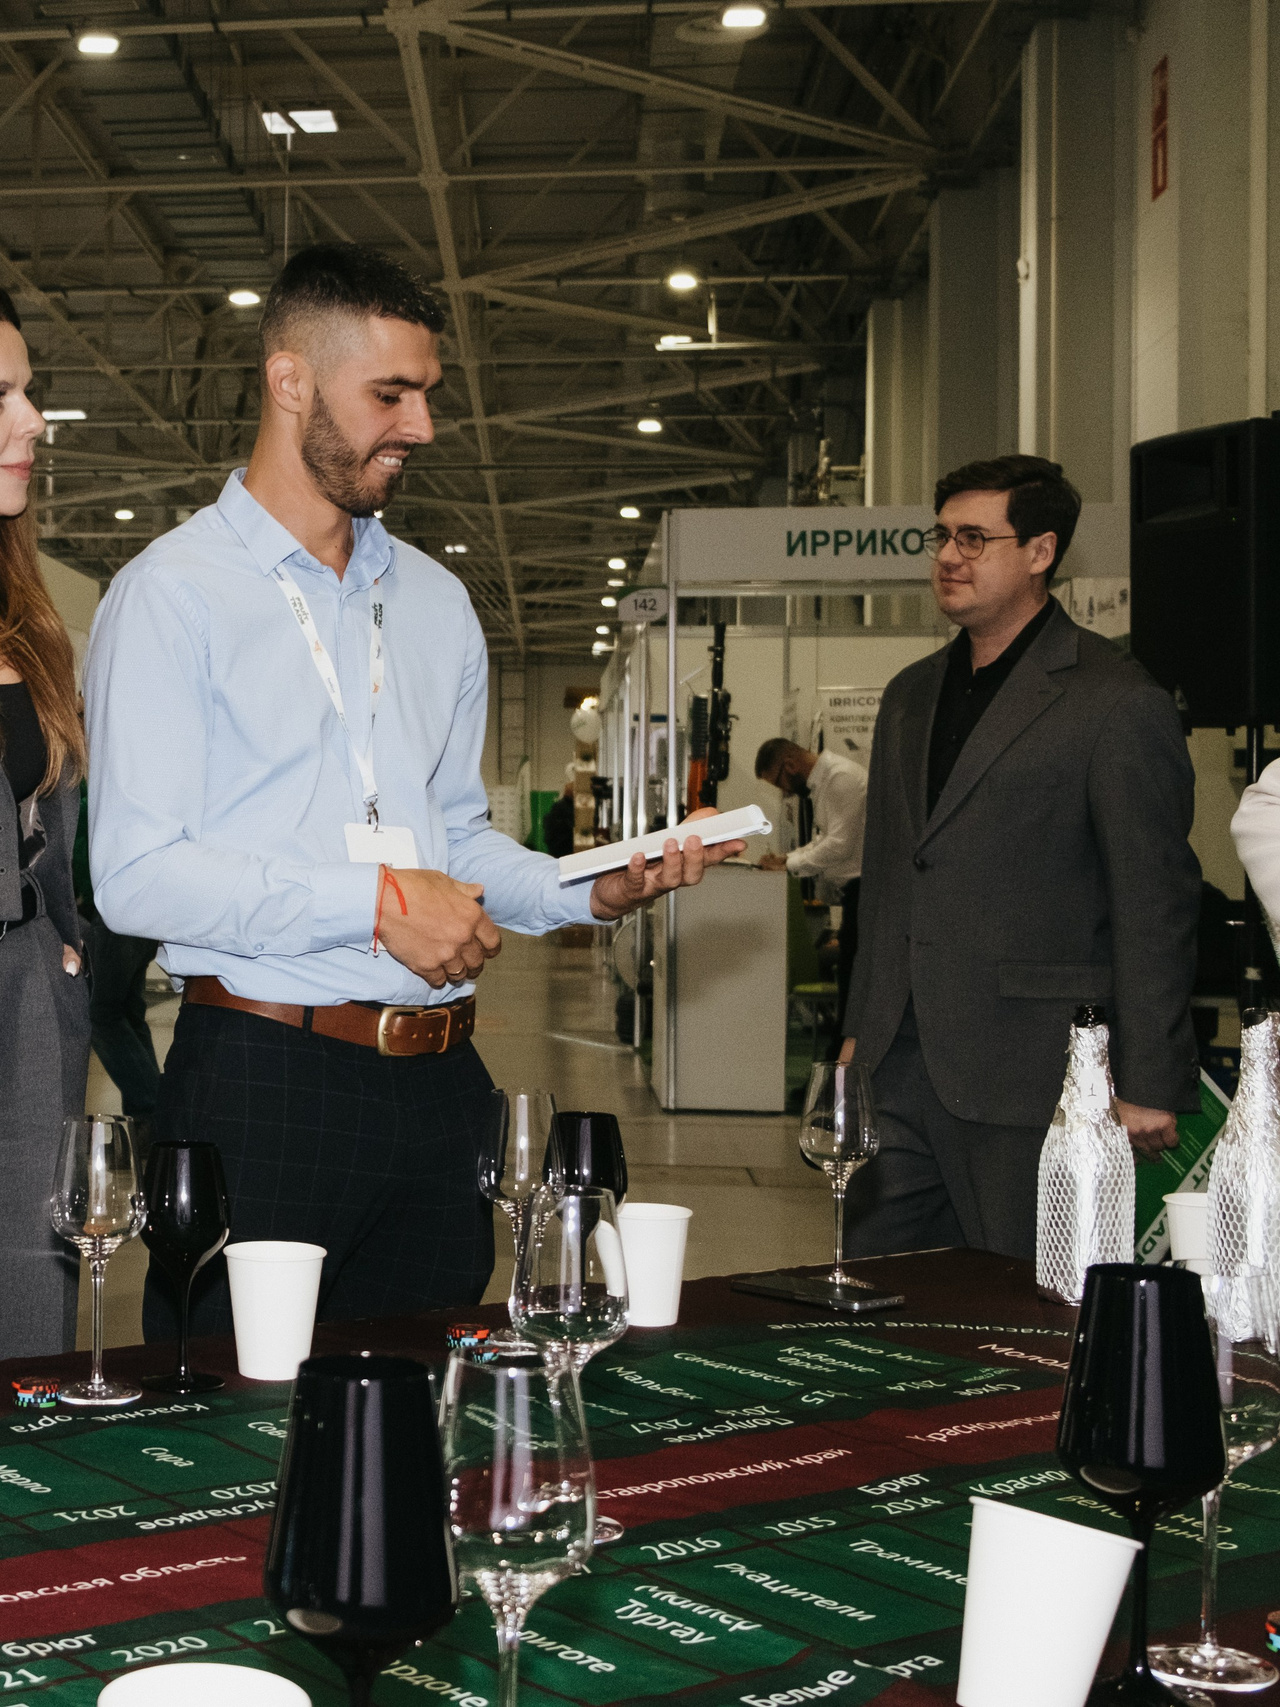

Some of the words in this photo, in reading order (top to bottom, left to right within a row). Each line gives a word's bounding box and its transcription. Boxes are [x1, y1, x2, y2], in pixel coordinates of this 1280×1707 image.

[633, 598, 657, 611] 142
[10, 1414, 85, 1433] орта
[630, 1418, 693, 1434] 2017
[141, 1446, 195, 1468] Сира
[789, 1448, 853, 1467] край
[857, 1473, 931, 1497] Брют
[53, 1505, 137, 1523] 2021
[135, 1498, 276, 1530] усладкое
[764, 1516, 837, 1537] 2015
[639, 1536, 722, 1561] 2016
[118, 1555, 248, 1583] область
[713, 1562, 877, 1622] Ркацители
[614, 1598, 717, 1645] Тургау
[1, 1633, 99, 1657] брют
[110, 1635, 210, 1665] 2020
[490, 1625, 617, 1674] лиготе
